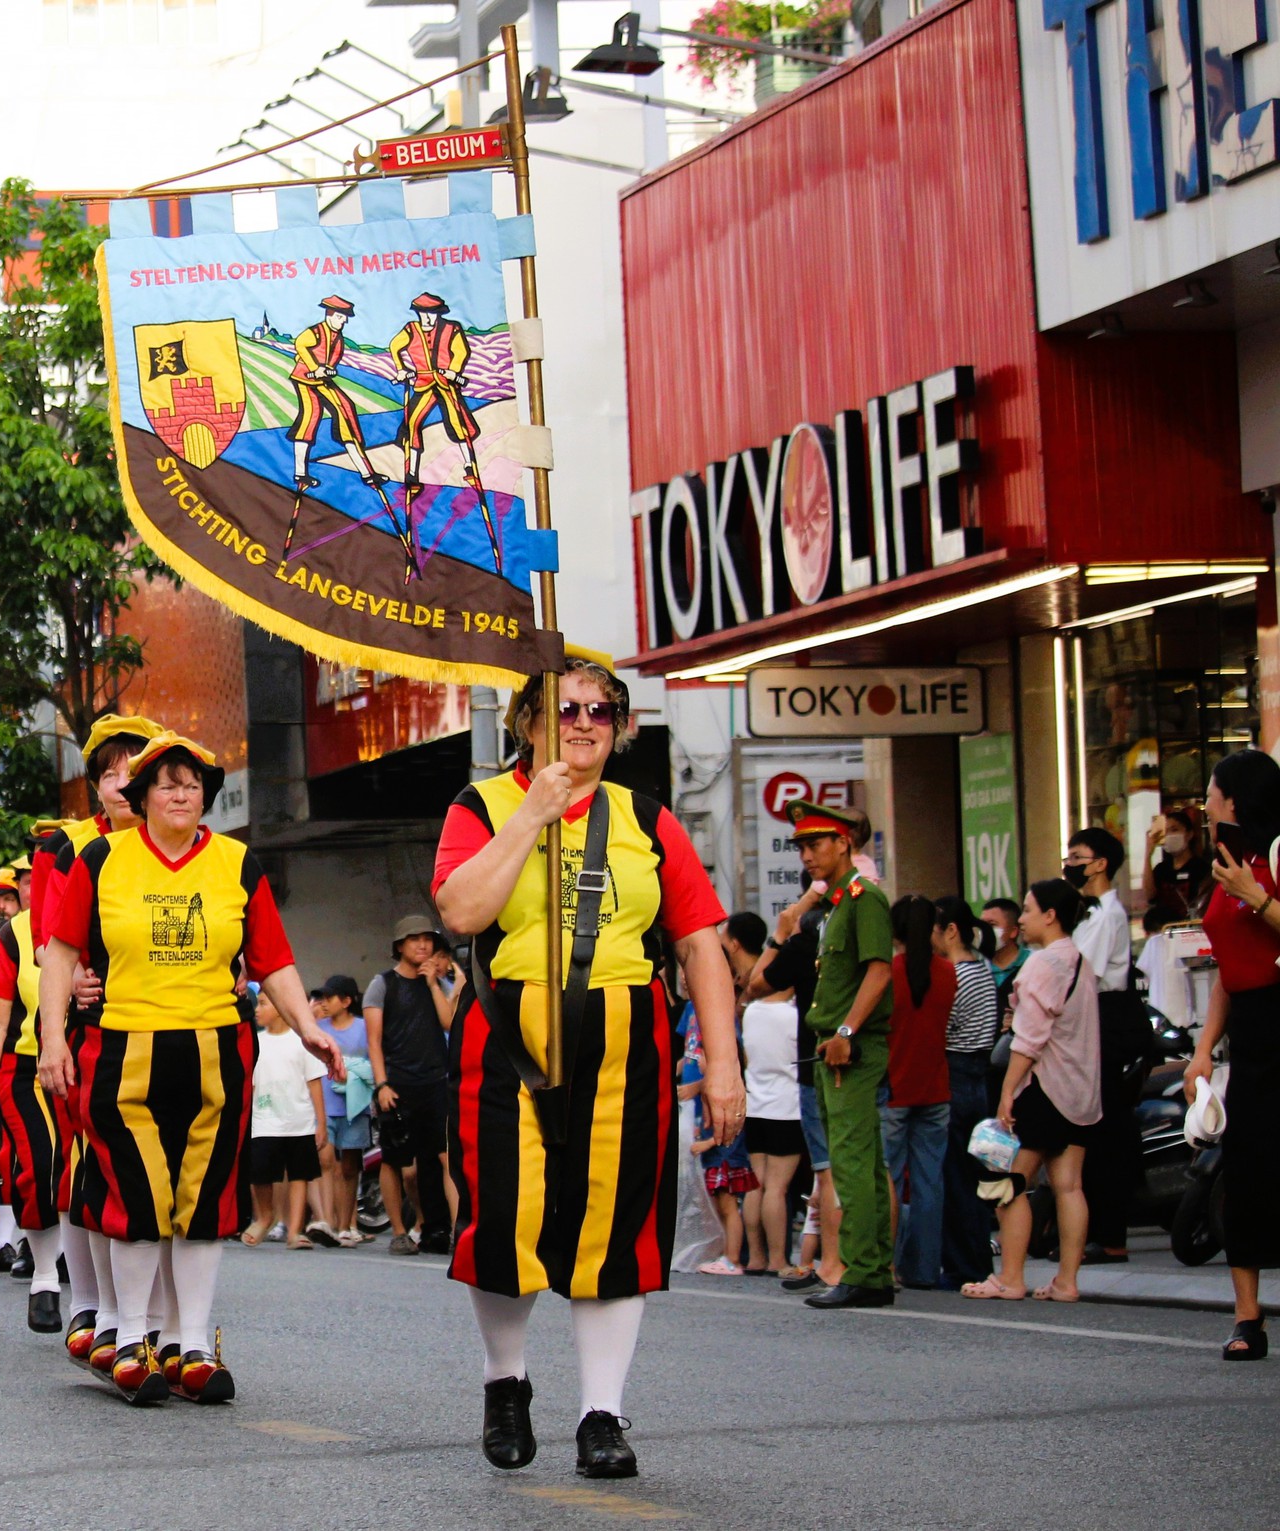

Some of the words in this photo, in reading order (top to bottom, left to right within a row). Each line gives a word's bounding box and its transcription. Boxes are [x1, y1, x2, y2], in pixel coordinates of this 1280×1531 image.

[396, 135, 486, 166] BELGIUM
[130, 260, 298, 287] STELTENLOPERS
[303, 256, 355, 276] VAN
[361, 243, 481, 274] MERCHTEM
[156, 456, 267, 566] STICHTING
[275, 561, 446, 629] LANGEVELDE
[461, 611, 520, 640] 1945
[967, 832, 1013, 902] 19K
[143, 894, 188, 905] MERCHTEMSE
[148, 950, 203, 962] STELTENLOPERS
